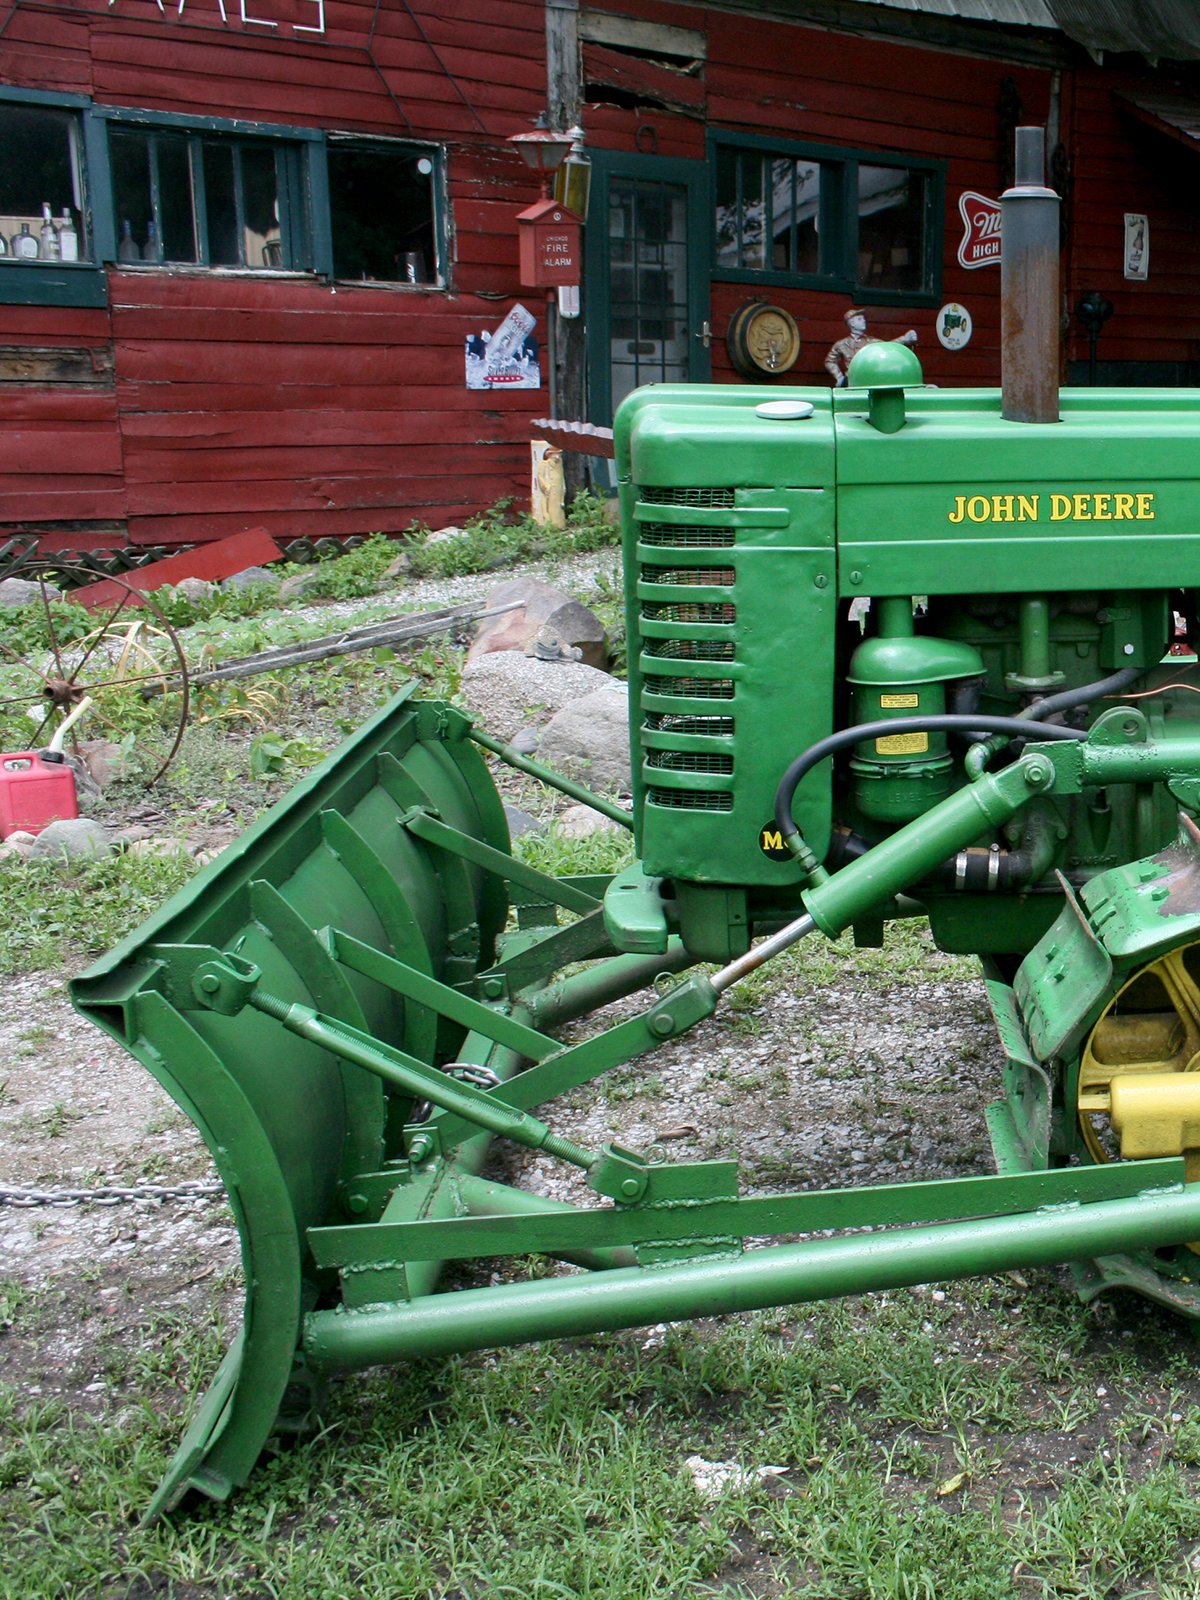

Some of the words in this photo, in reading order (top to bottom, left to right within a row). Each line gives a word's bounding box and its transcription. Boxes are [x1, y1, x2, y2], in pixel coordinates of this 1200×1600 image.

[546, 244, 568, 252] FIRE
[973, 242, 999, 258] HIGH
[544, 258, 572, 267] ALARM
[948, 494, 1040, 523] JOHN
[1049, 493, 1155, 521] DEERE
[762, 831, 789, 850] M
